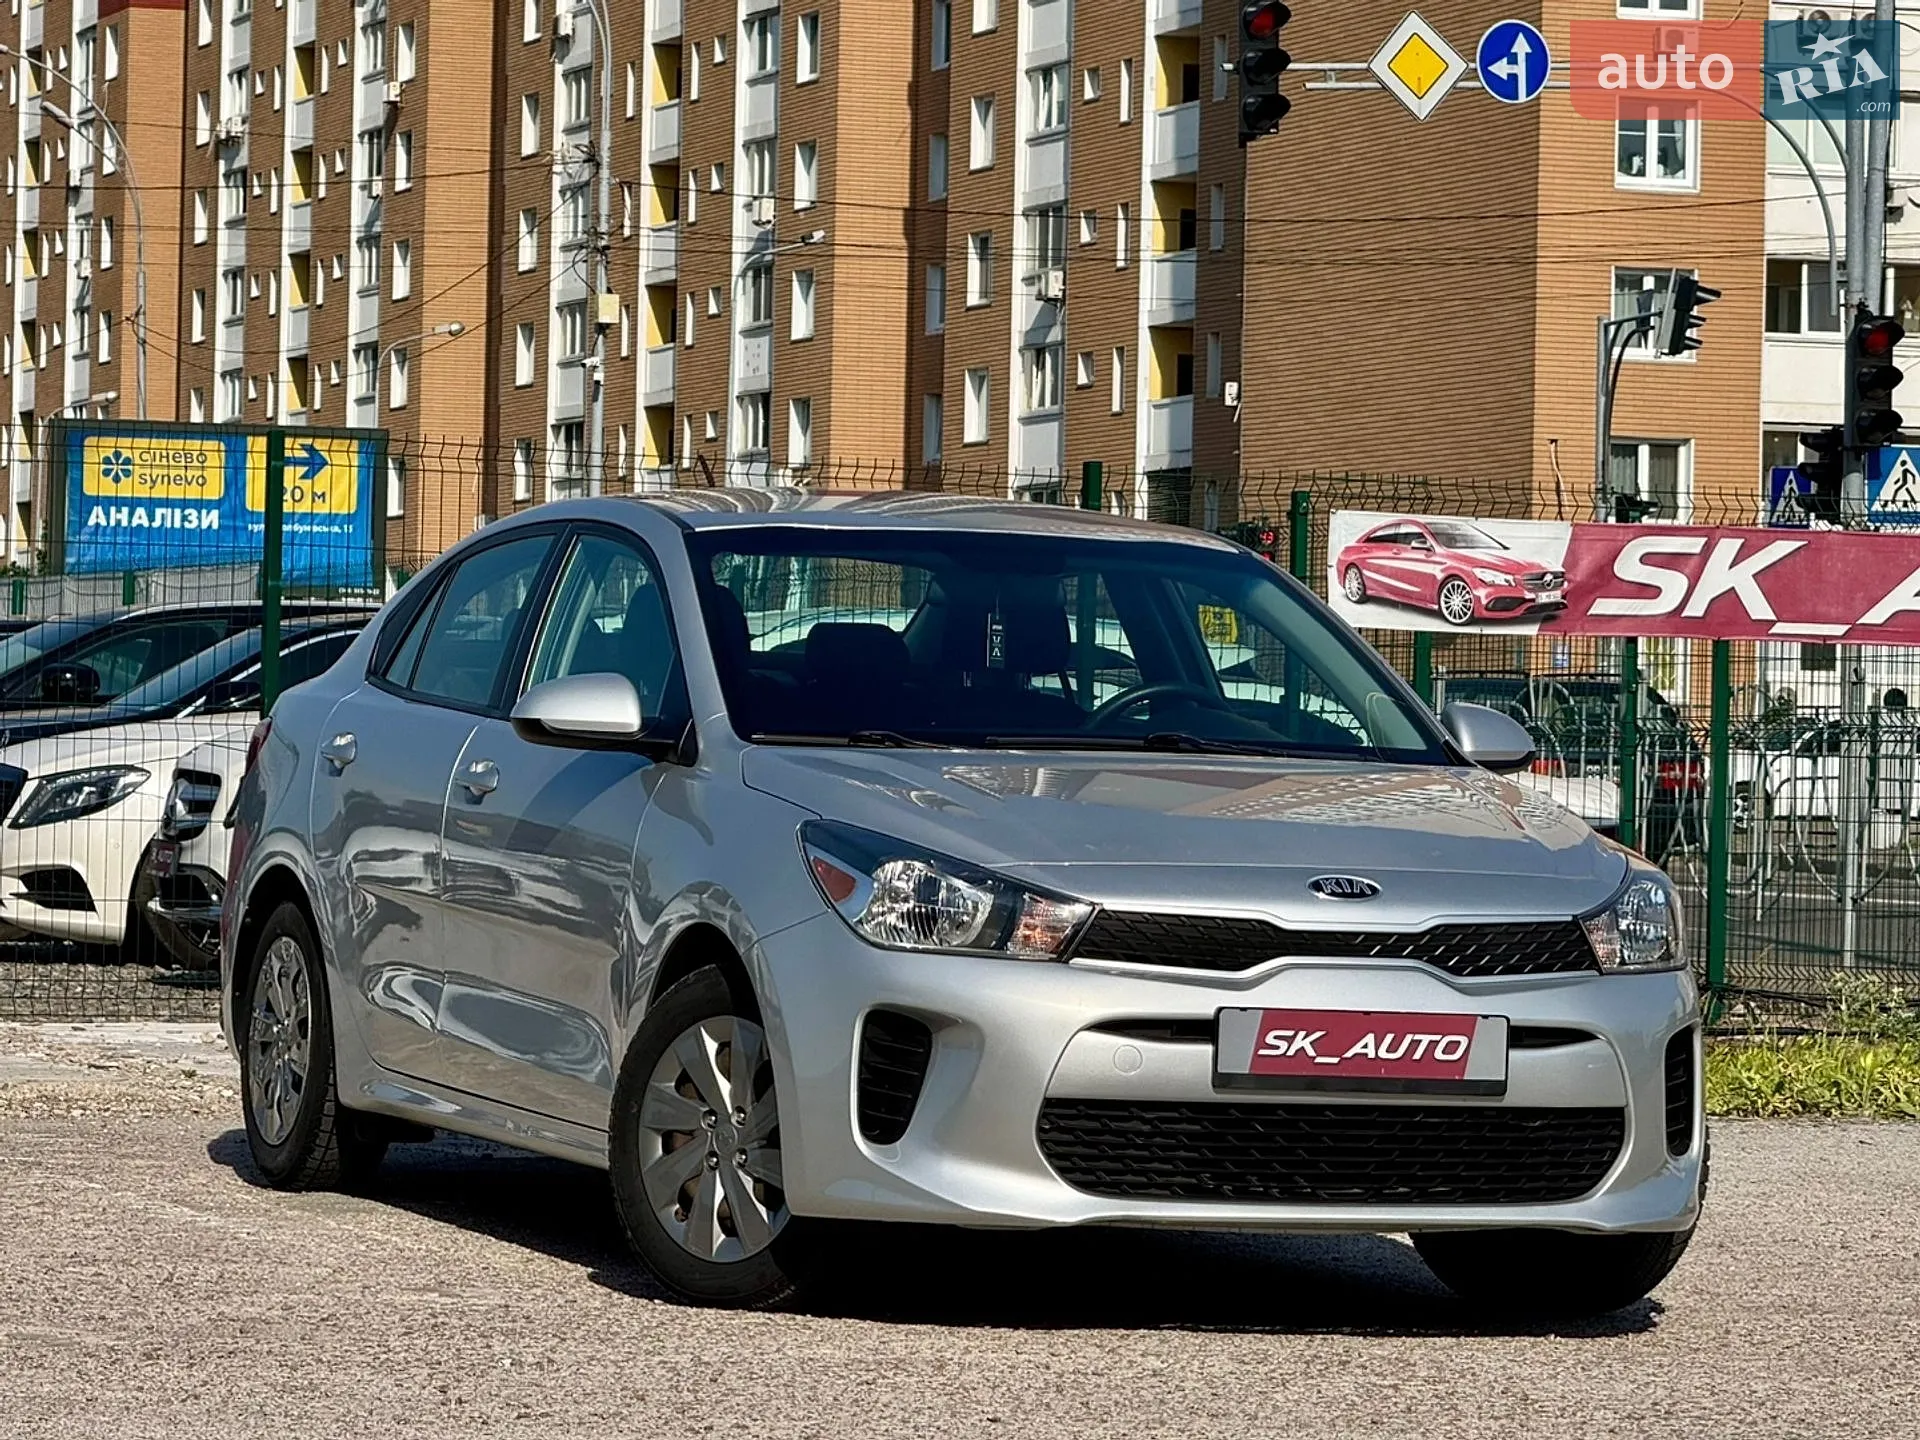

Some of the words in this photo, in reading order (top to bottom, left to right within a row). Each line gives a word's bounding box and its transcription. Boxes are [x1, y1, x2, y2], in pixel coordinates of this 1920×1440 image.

[138, 472, 208, 490] synevo
[87, 505, 220, 529] АНАЛІЗИ
[1319, 878, 1372, 895] KIA
[1257, 1029, 1470, 1064] SK_AUTO
